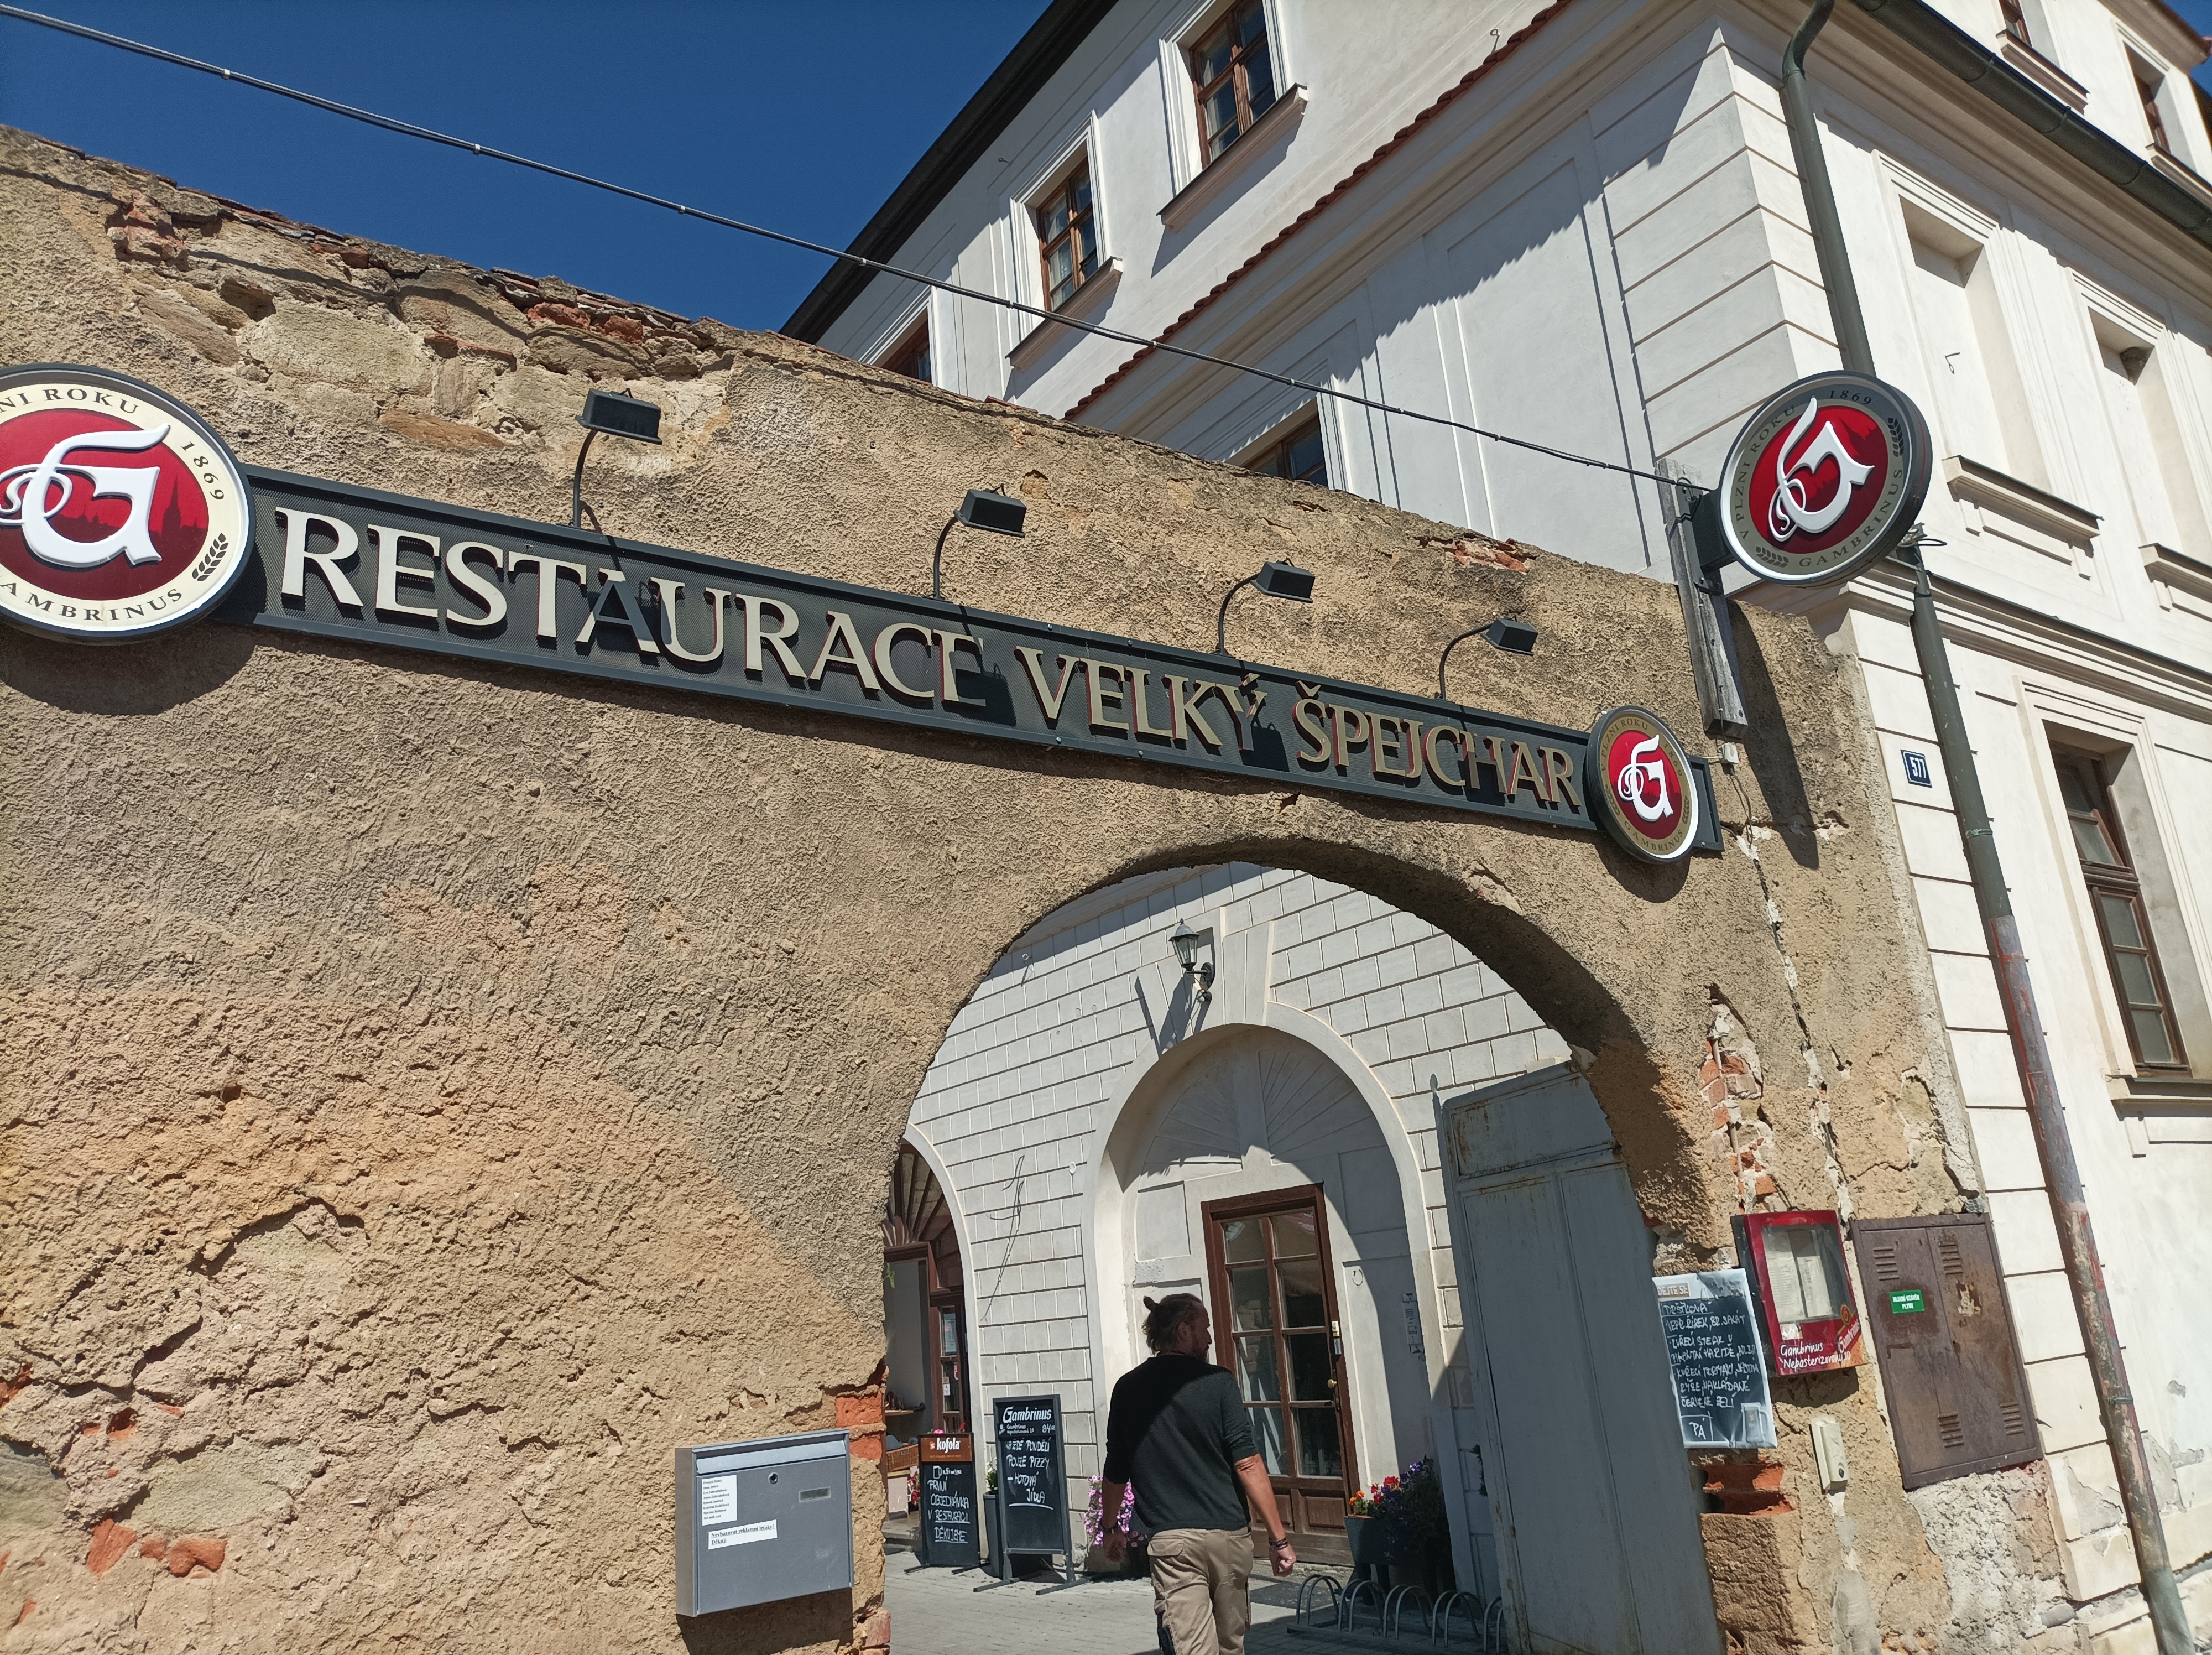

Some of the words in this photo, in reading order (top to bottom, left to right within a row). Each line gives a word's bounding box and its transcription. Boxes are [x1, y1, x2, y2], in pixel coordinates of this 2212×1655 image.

[1750, 405, 1796, 454] ROKU
[1829, 389, 1872, 405] 1869
[43, 388, 140, 414] ROKU
[181, 441, 225, 501] 1869
[1799, 469, 1902, 567] GAMBRINUS
[0, 582, 182, 621] AMBRINUS
[276, 507, 987, 707] RESTAURACE
[1014, 646, 1267, 751] VELKÝ
[1292, 680, 1582, 807] ŠPEJCHAR
[1620, 718, 1648, 730] ROKU
[1664, 743, 1683, 776] 1869
[1910, 756, 1926, 779] 577
[1624, 821, 1683, 851] GAMBRINUS
[1697, 1335, 1724, 1346] STEAK
[1780, 1341, 1823, 1357] Gambrinus
[1003, 1406, 1052, 1423] Gambrinus
[937, 1437, 960, 1454] kofola
[1006, 1454, 1027, 1467] POUZE
[1029, 1455, 1050, 1470] PIZZY
[927, 1476, 947, 1491] PRVNÍ
[1014, 1471, 1039, 1486] HOTOVÁ
[931, 1490, 969, 1509] OBJEDNÁVKA
[1026, 1487, 1045, 1503] JÍDLA
[928, 1509, 932, 1520] V
[935, 1509, 968, 1522] RESTAURACI
